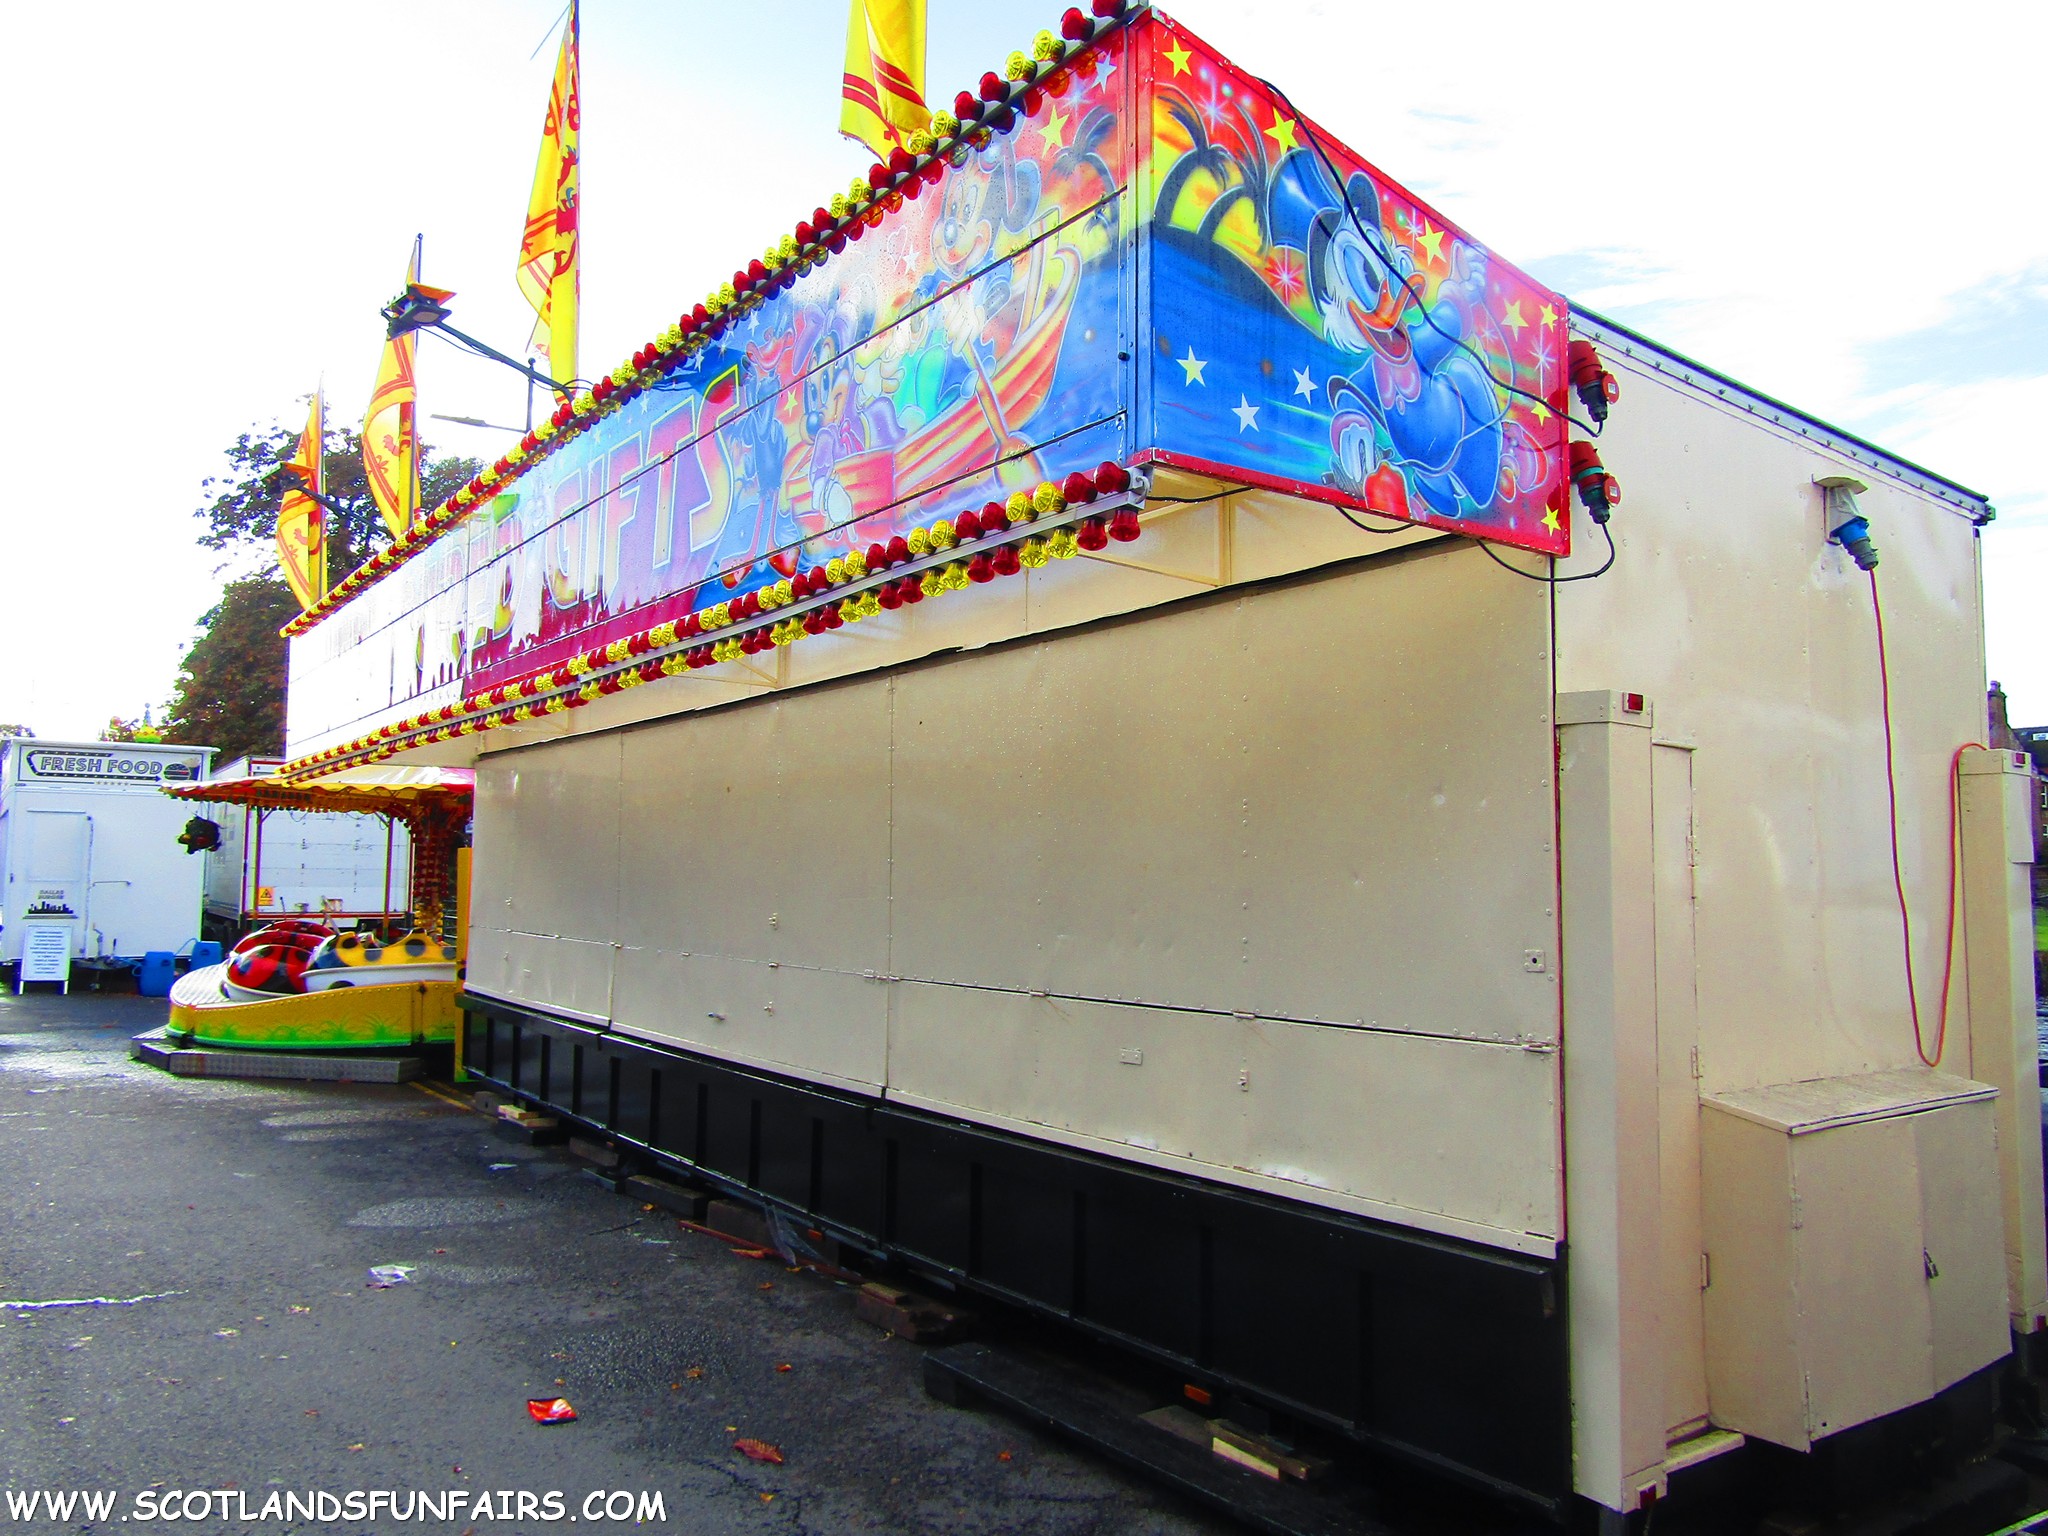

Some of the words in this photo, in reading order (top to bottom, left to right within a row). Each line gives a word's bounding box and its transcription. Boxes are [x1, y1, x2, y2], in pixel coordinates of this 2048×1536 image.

[544, 363, 740, 611] GIFTS
[40, 756, 102, 773] FRESH
[107, 759, 163, 775] FOOD
